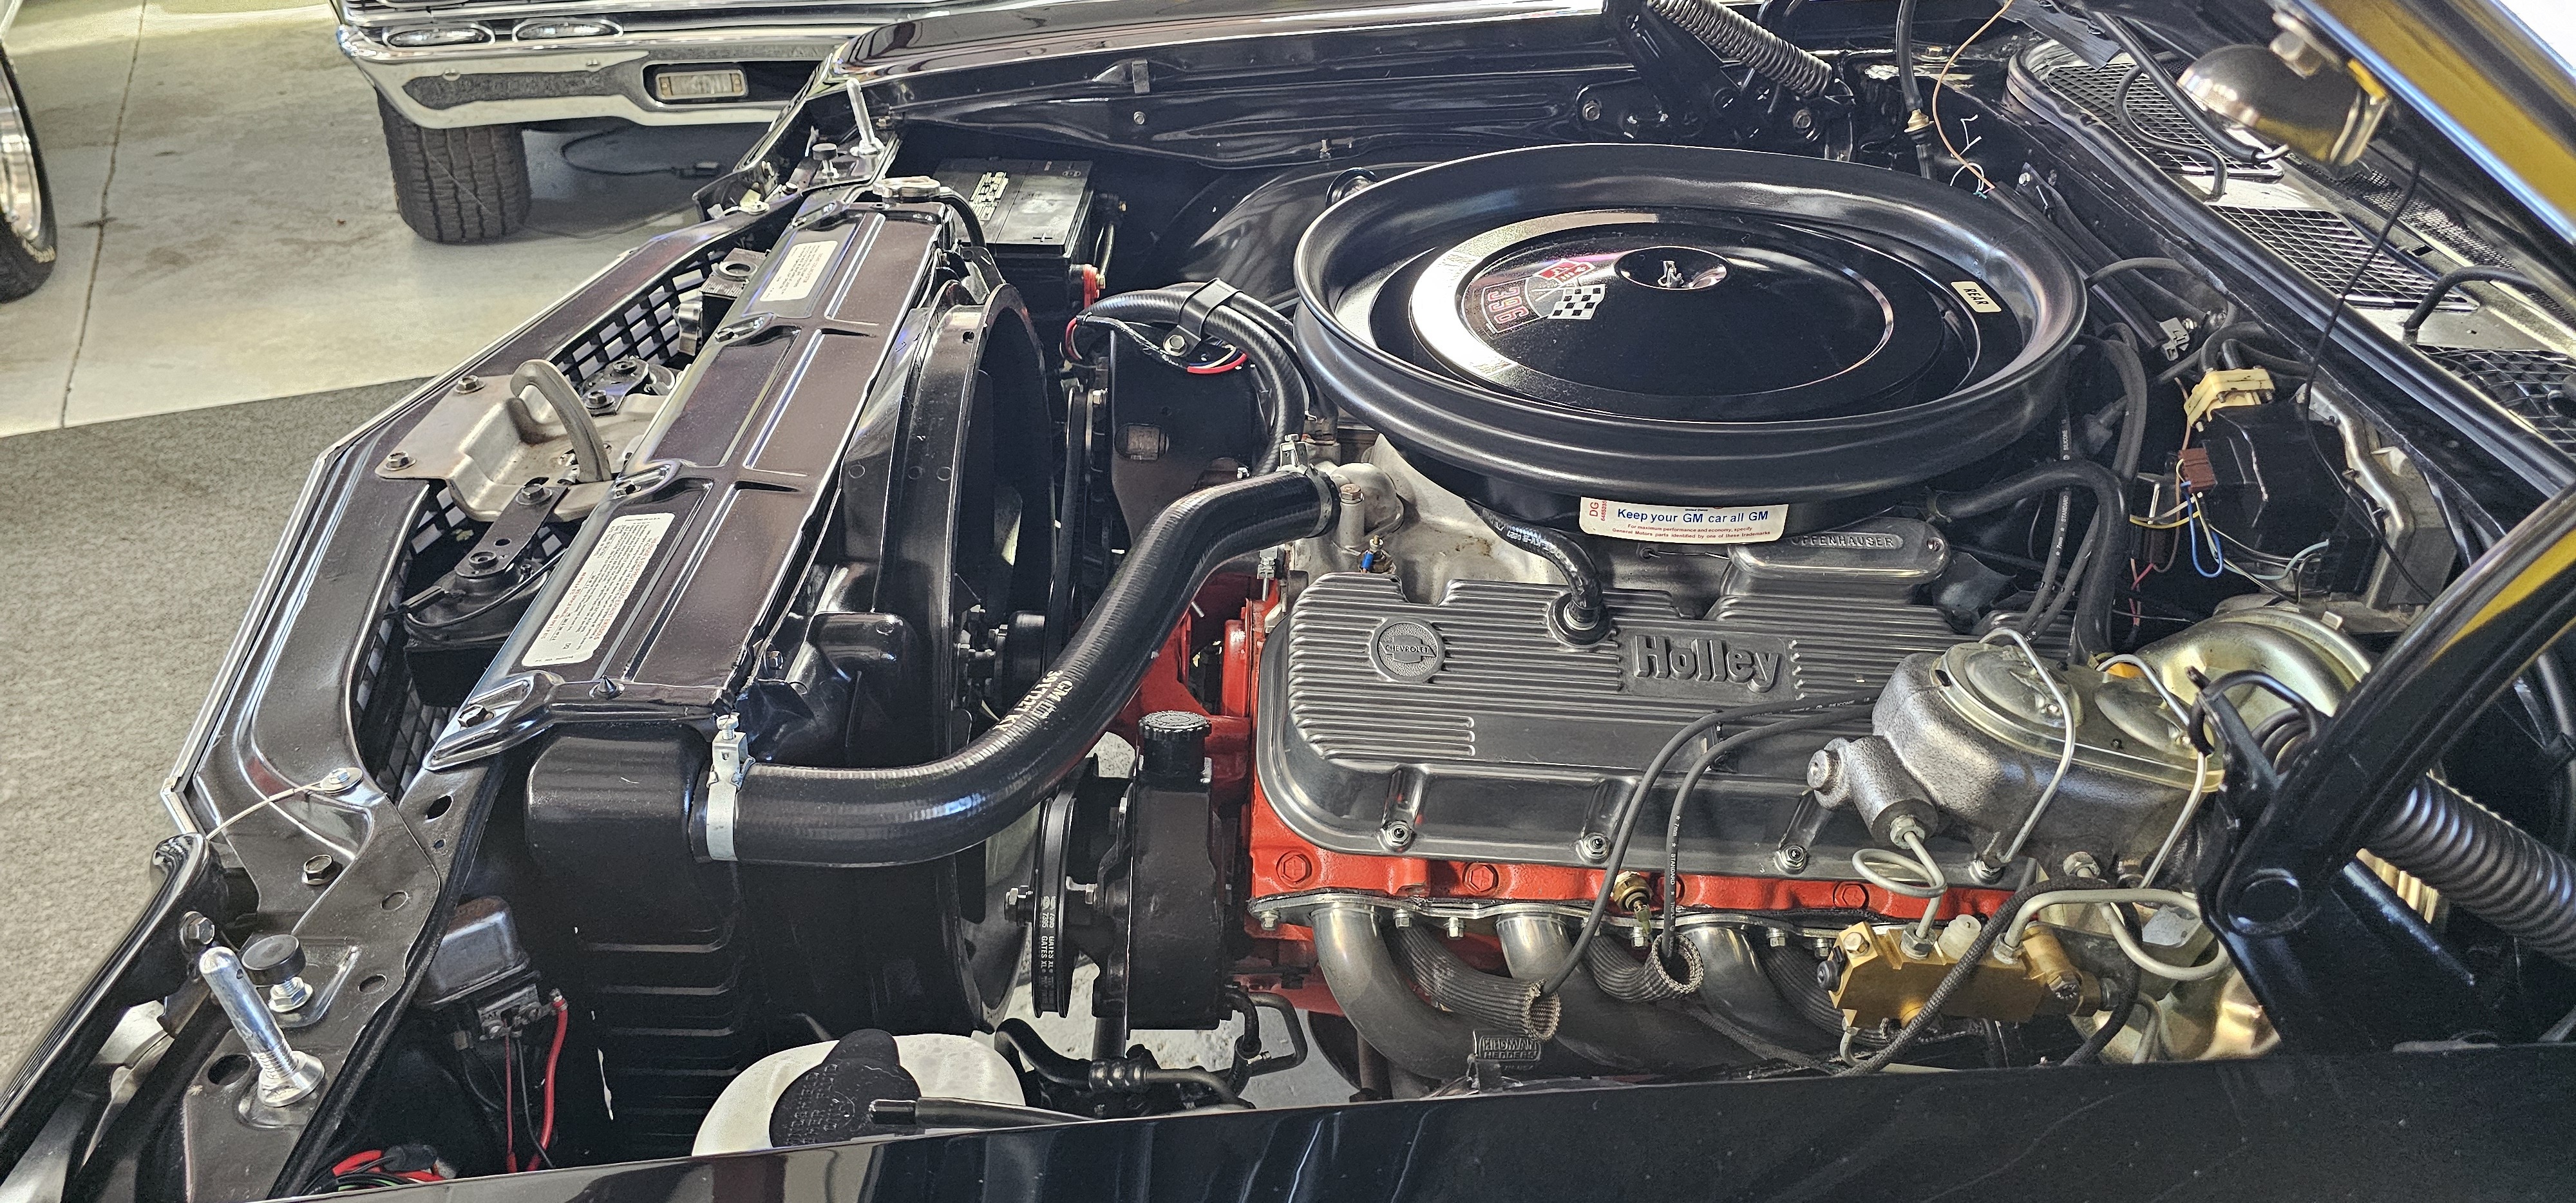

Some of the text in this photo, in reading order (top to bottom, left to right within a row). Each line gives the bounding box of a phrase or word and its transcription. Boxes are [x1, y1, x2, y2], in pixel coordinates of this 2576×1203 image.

[1963, 289, 1989, 305] REAR
[1487, 286, 1530, 325] 396
[1589, 502, 1599, 517] DG
[1618, 509, 1768, 524] Keep your GM car all GM
[1385, 645, 1429, 653] CHEVROLET
[1631, 635, 1783, 694] Holley
[1047, 680, 1073, 701] GM
